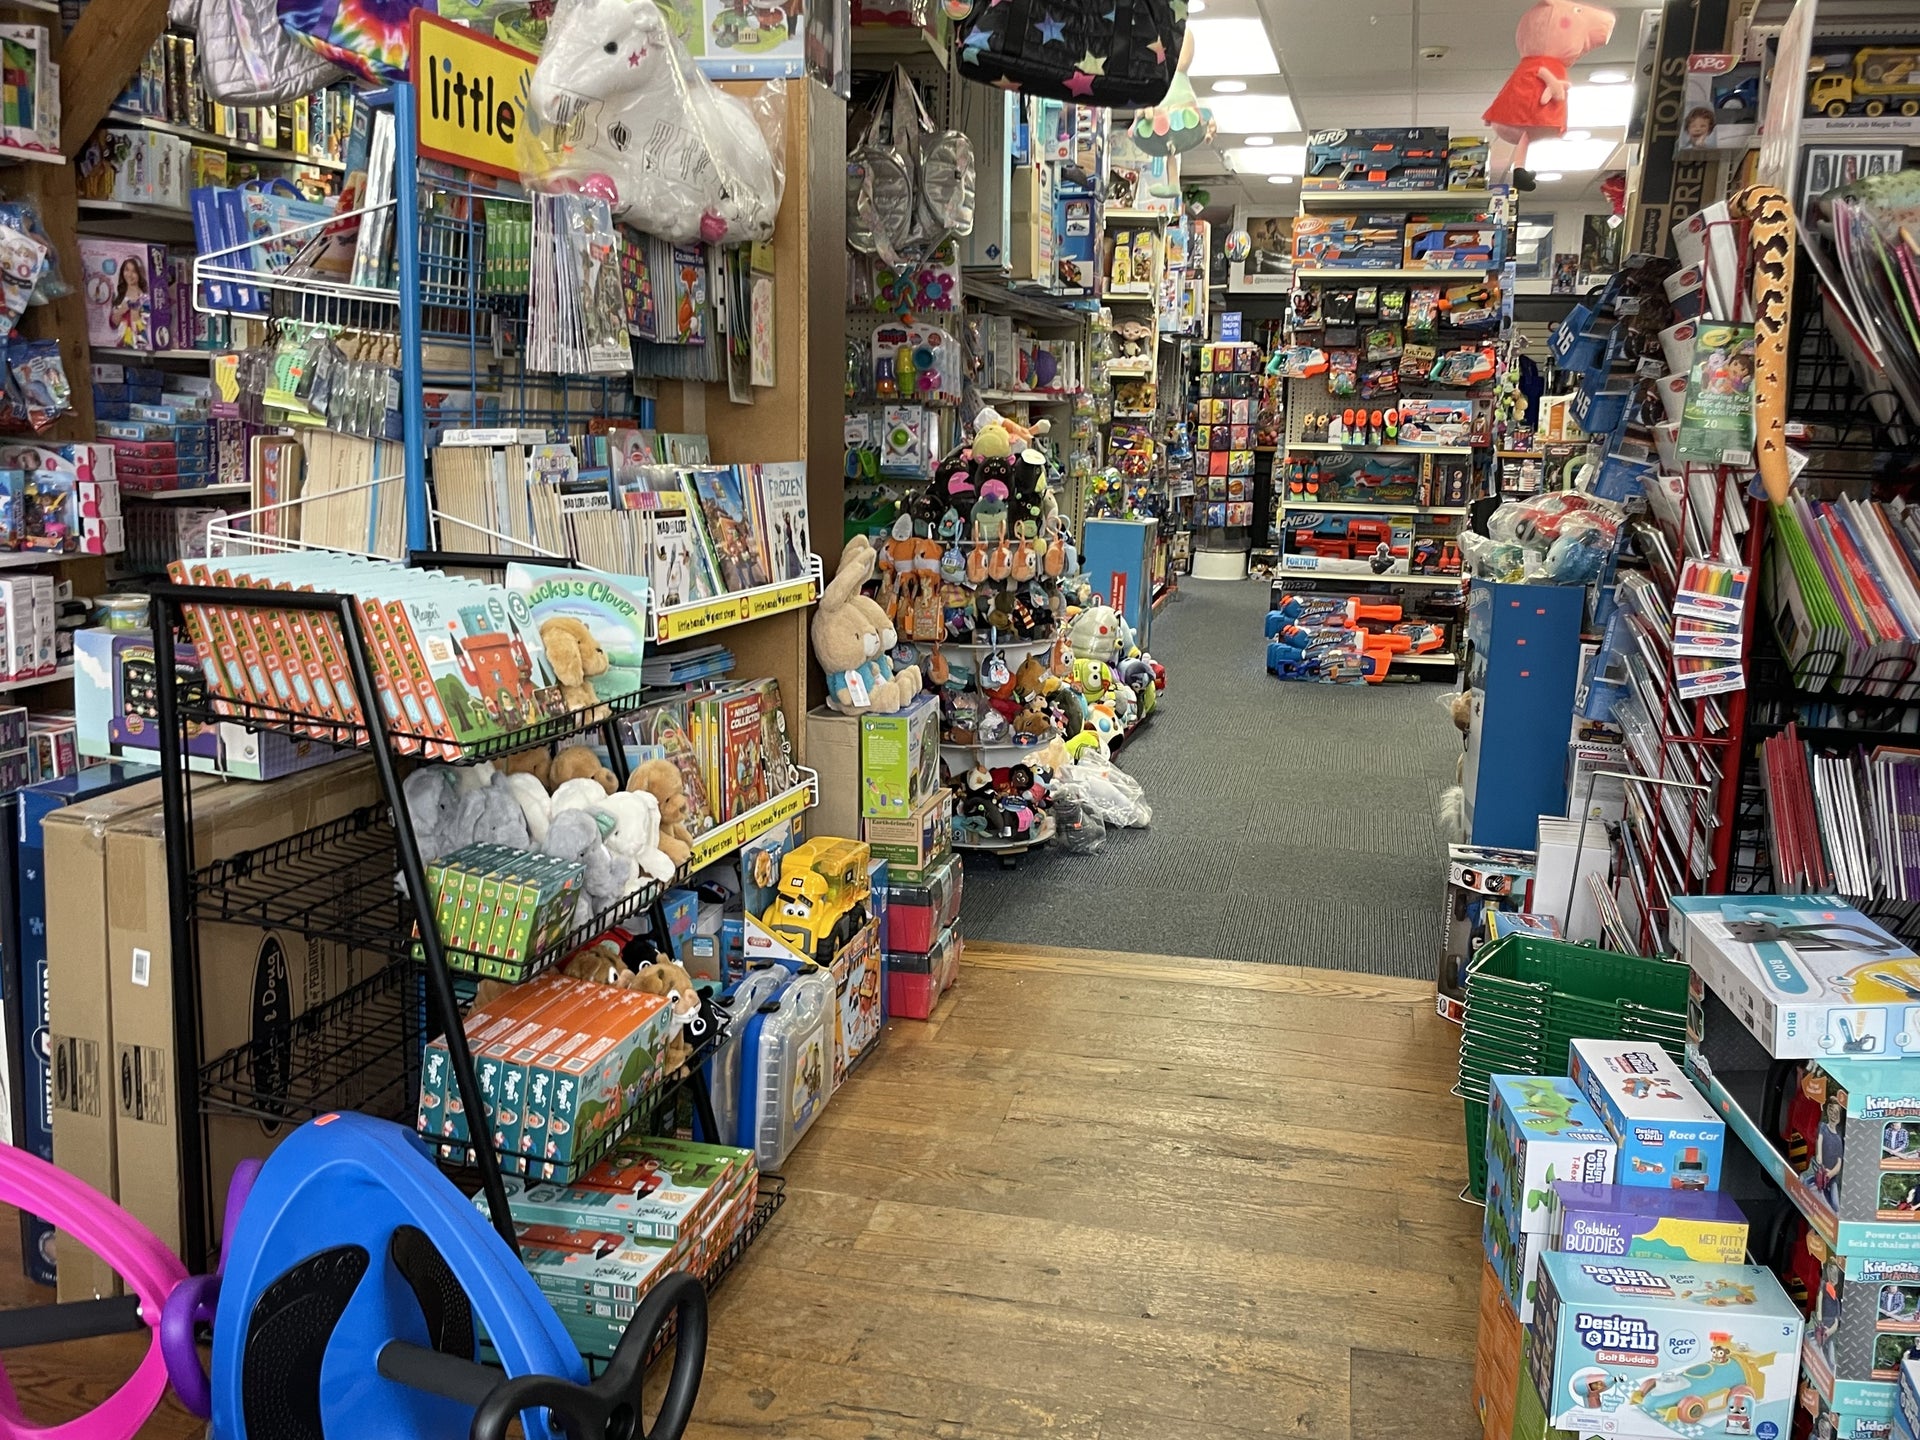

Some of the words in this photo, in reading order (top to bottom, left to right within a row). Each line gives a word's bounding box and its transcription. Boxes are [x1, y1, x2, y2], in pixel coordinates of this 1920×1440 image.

[1693, 57, 1726, 69] ABC
[429, 55, 515, 144] little
[1651, 57, 1687, 143] TOYS
[1306, 130, 1345, 147] NERF
[1387, 180, 1425, 188] ELITE
[1556, 321, 1575, 355] 46
[1405, 348, 1433, 358] ULTRA
[1698, 391, 1733, 402] Coloring
[1735, 395, 1750, 403] Pad
[1576, 388, 1591, 420] 46
[1696, 399, 1713, 408] Bloc
[1726, 403, 1749, 412] pages
[1709, 409, 1740, 417] colorier
[1704, 419, 1718, 428] 20
[1316, 453, 1352, 467] NERF
[768, 475, 803, 500] FROZEN
[563, 497, 575, 508] MAD
[575, 497, 585, 508] LIBS
[656, 521, 670, 535] MAD
[675, 520, 687, 533] LIBS
[1282, 513, 1323, 529] NERF
[1286, 558, 1318, 567] FORTNITE
[588, 581, 638, 617] Clover
[744, 601, 766, 613] little
[765, 599, 777, 610] hands
[782, 596, 793, 606] giant
[792, 592, 803, 602] steps
[677, 621, 691, 632] little
[690, 617, 705, 629] hands
[711, 613, 724, 624] giant
[724, 608, 736, 619] steps
[734, 703, 759, 718] NINTENDO
[871, 819, 915, 828] Earth-friendly
[720, 837, 733, 849] steps
[792, 878, 803, 886] CAT
[308, 938, 320, 988] PEDIATRIC
[1768, 959, 1792, 981] BRIO
[261, 950, 286, 1006] Doug
[1787, 1011, 1797, 1038] BRIO
[1861, 1109, 1884, 1118] JUST
[1635, 1128, 1659, 1136] Design
[1645, 1133, 1663, 1142] Drill
[1669, 1130, 1695, 1141] Race
[1699, 1131, 1720, 1141] Car
[1570, 1156, 1581, 1181] T-Rex
[1594, 1150, 1606, 1183] Design
[1574, 1220, 1622, 1237] Bobbin'
[1698, 1234, 1717, 1245] MER
[1720, 1236, 1746, 1247] KITTY
[1865, 1231, 1897, 1240] Power
[1565, 1234, 1625, 1255] BUDDIES
[1848, 1240, 1869, 1249] Scie
[1583, 1265, 1649, 1279] Design
[1863, 1259, 1918, 1274] Kidoozie
[1613, 1274, 1668, 1289] Drill
[1669, 1273, 1695, 1281] Race
[1858, 1272, 1880, 1282] JUST
[1881, 1272, 1920, 1281] IMAGINE
[1615, 1286, 1635, 1294] Bolt
[1635, 1288, 1674, 1297] Buddies
[1578, 1314, 1646, 1334] Design
[1603, 1332, 1657, 1351] Drill
[1669, 1337, 1697, 1347] Race
[1671, 1346, 1692, 1355] Car
[1598, 1353, 1618, 1363] Bolt
[1619, 1354, 1656, 1366] Buddies
[1860, 1389, 1891, 1398] Power
[1843, 1397, 1863, 1406] Scie
